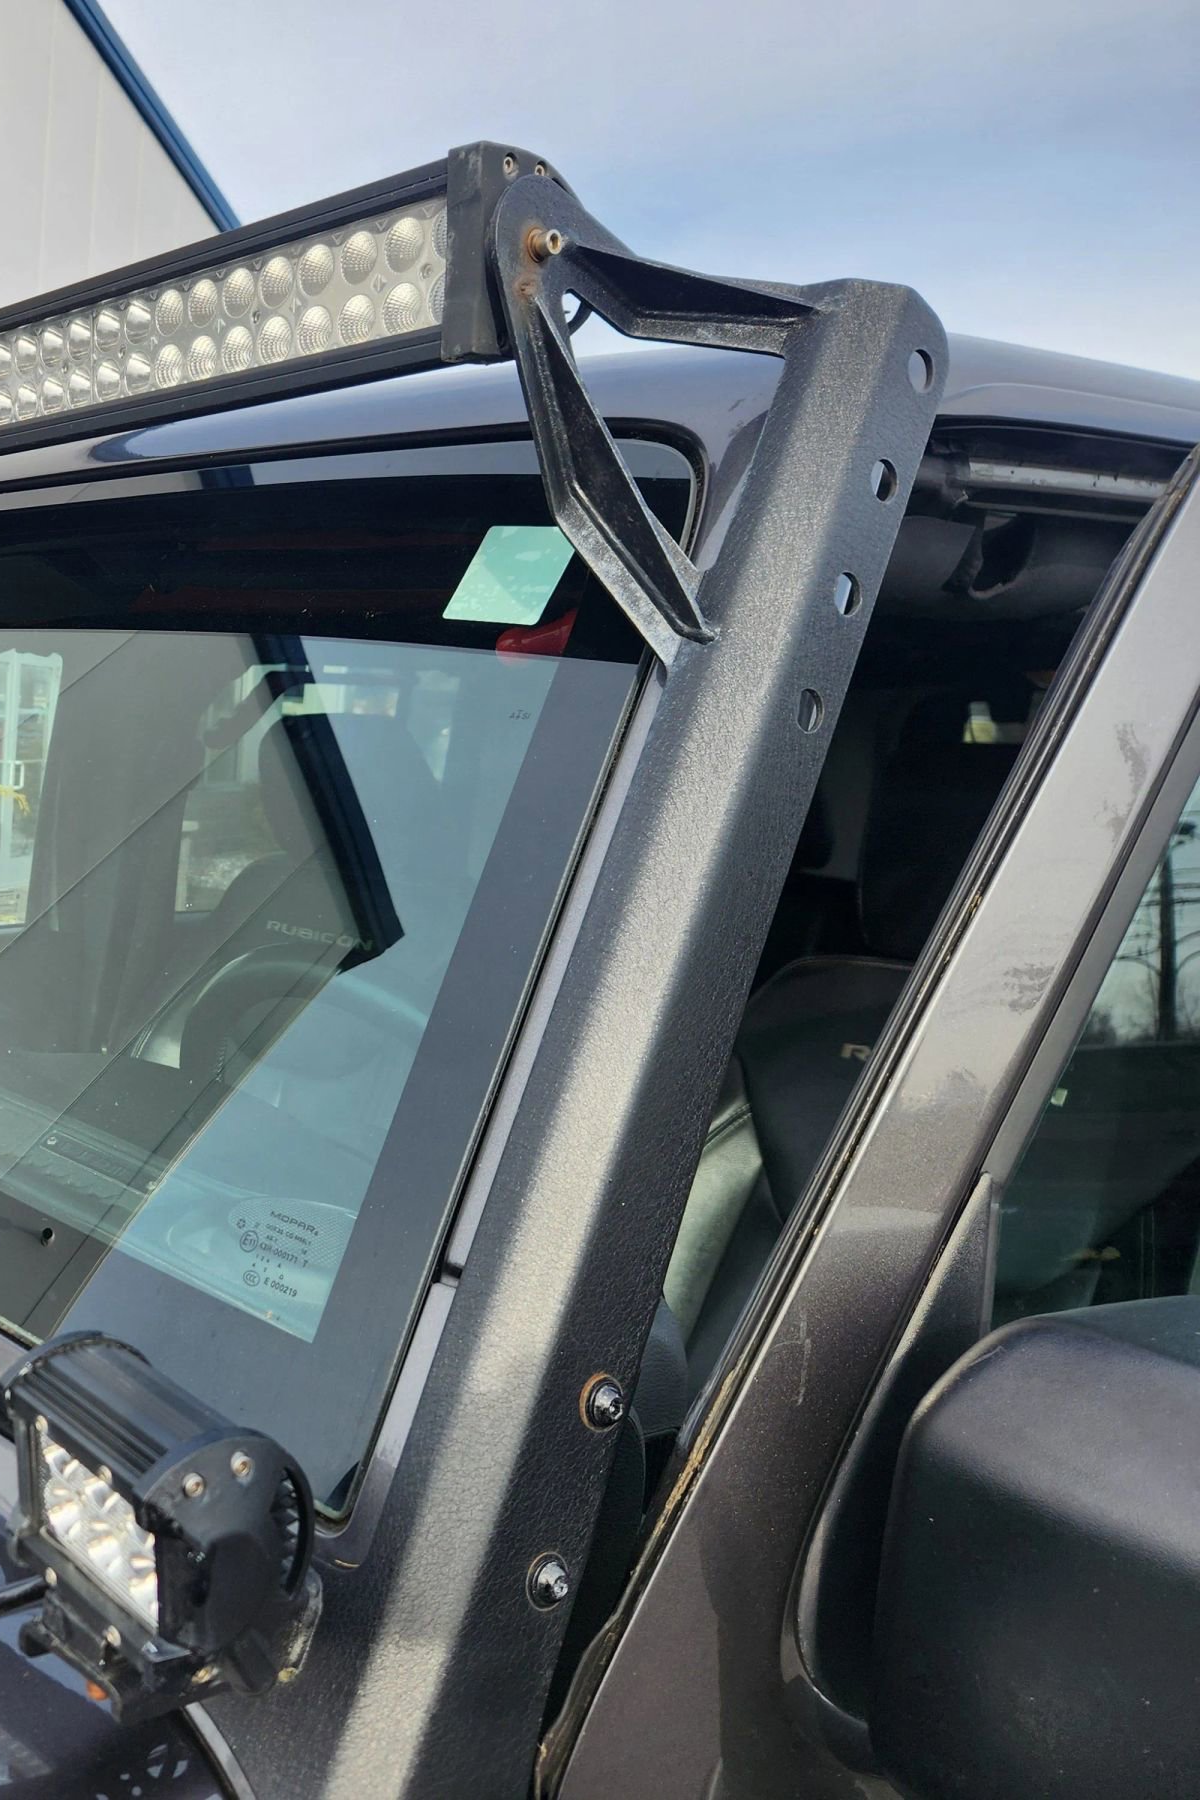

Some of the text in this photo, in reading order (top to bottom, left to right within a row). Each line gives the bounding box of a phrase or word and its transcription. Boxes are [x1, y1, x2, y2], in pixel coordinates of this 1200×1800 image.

[266, 920, 374, 951] RUBICON
[270, 1211, 316, 1234] MOPAR
[270, 1280, 298, 1298] 000219
